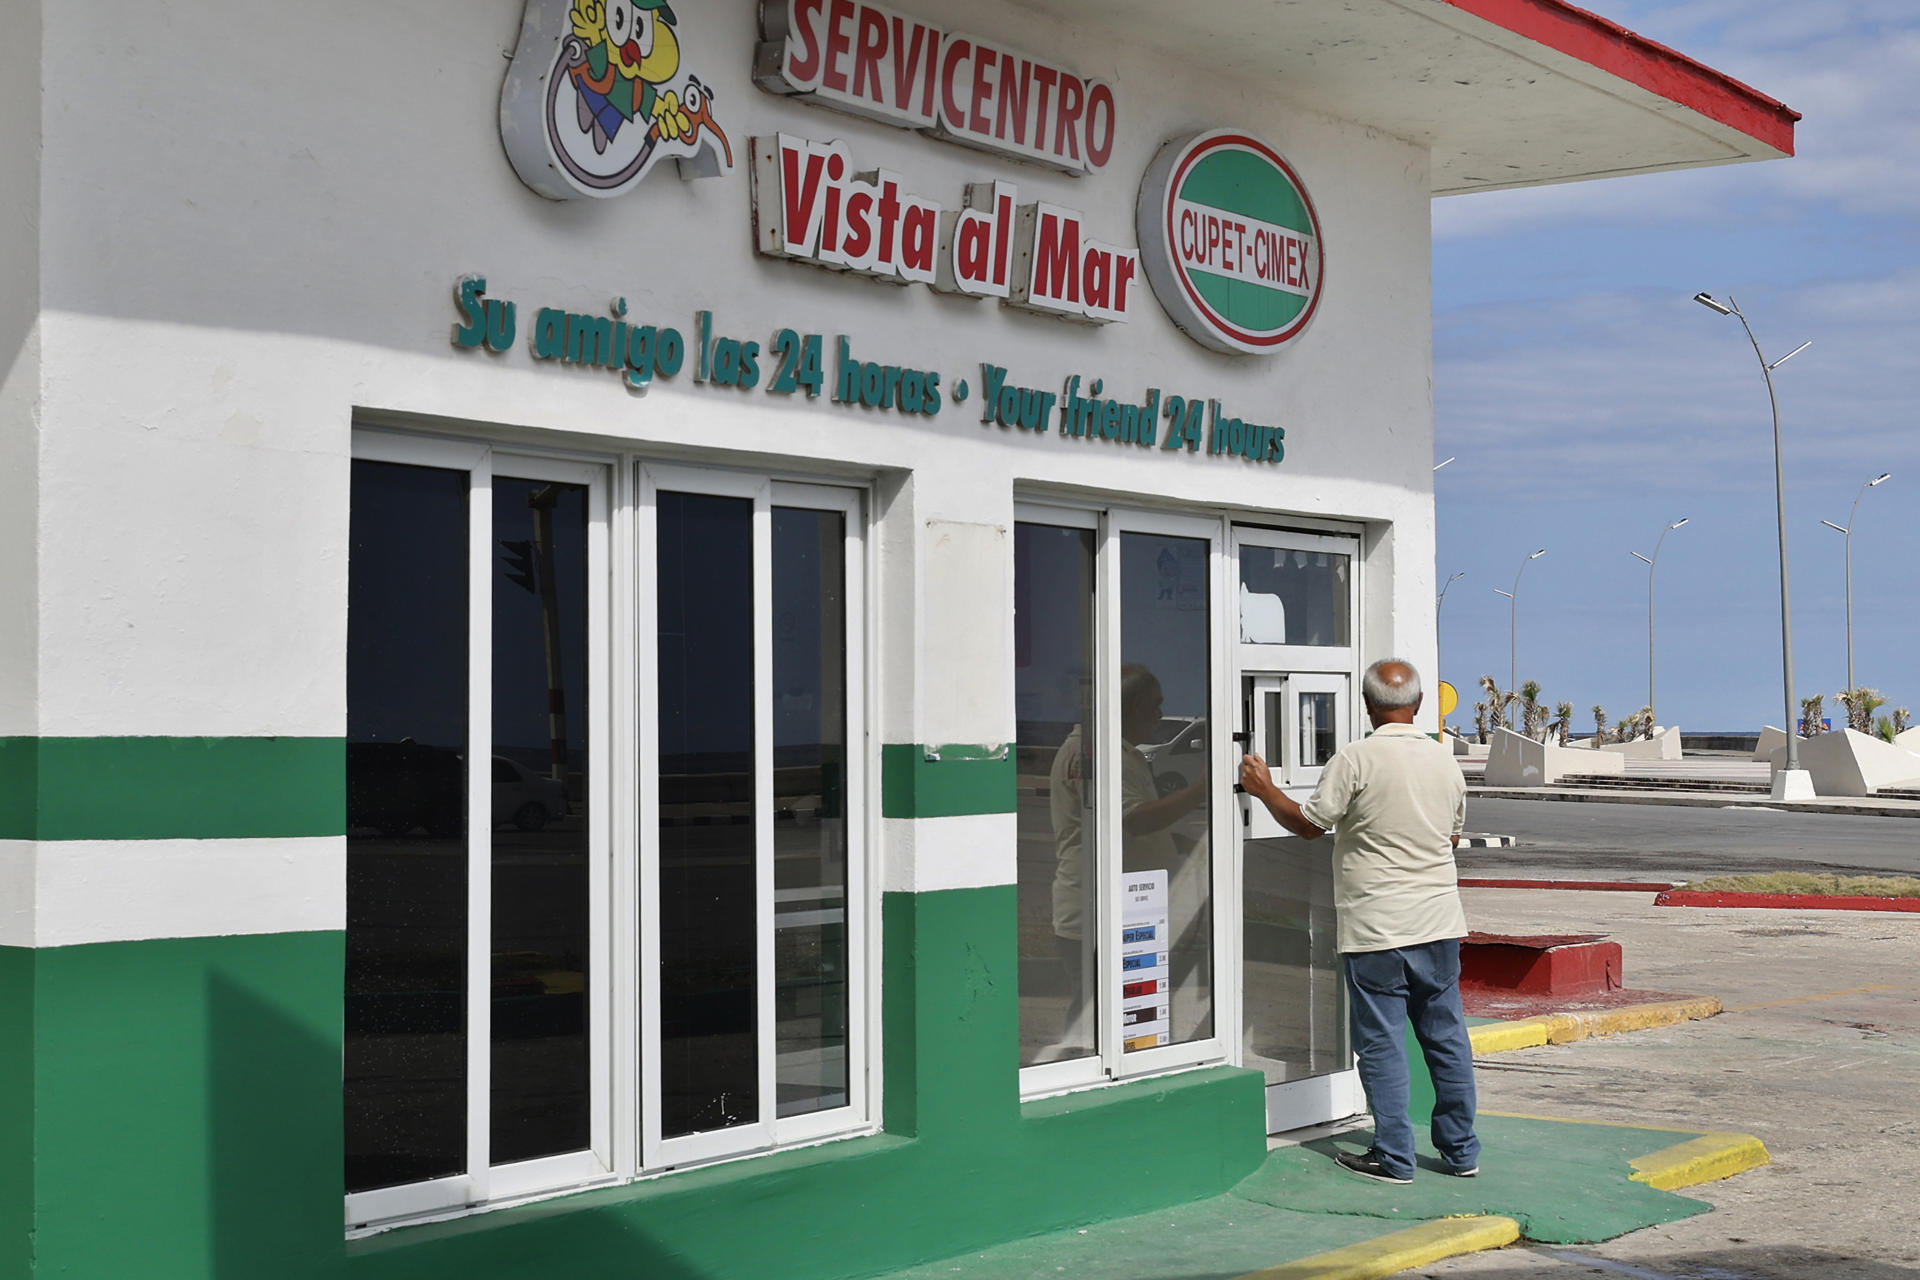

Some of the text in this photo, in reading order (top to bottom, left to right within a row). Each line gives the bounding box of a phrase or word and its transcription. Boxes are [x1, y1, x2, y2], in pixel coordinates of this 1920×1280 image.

[788, 0, 1115, 168] SERVICENTRO
[781, 146, 1136, 314] Vista al Mar
[1180, 207, 1310, 291] CUPET-CIMEX
[452, 273, 1286, 463] Su amigo las 24 horas Your friend 24 hours
